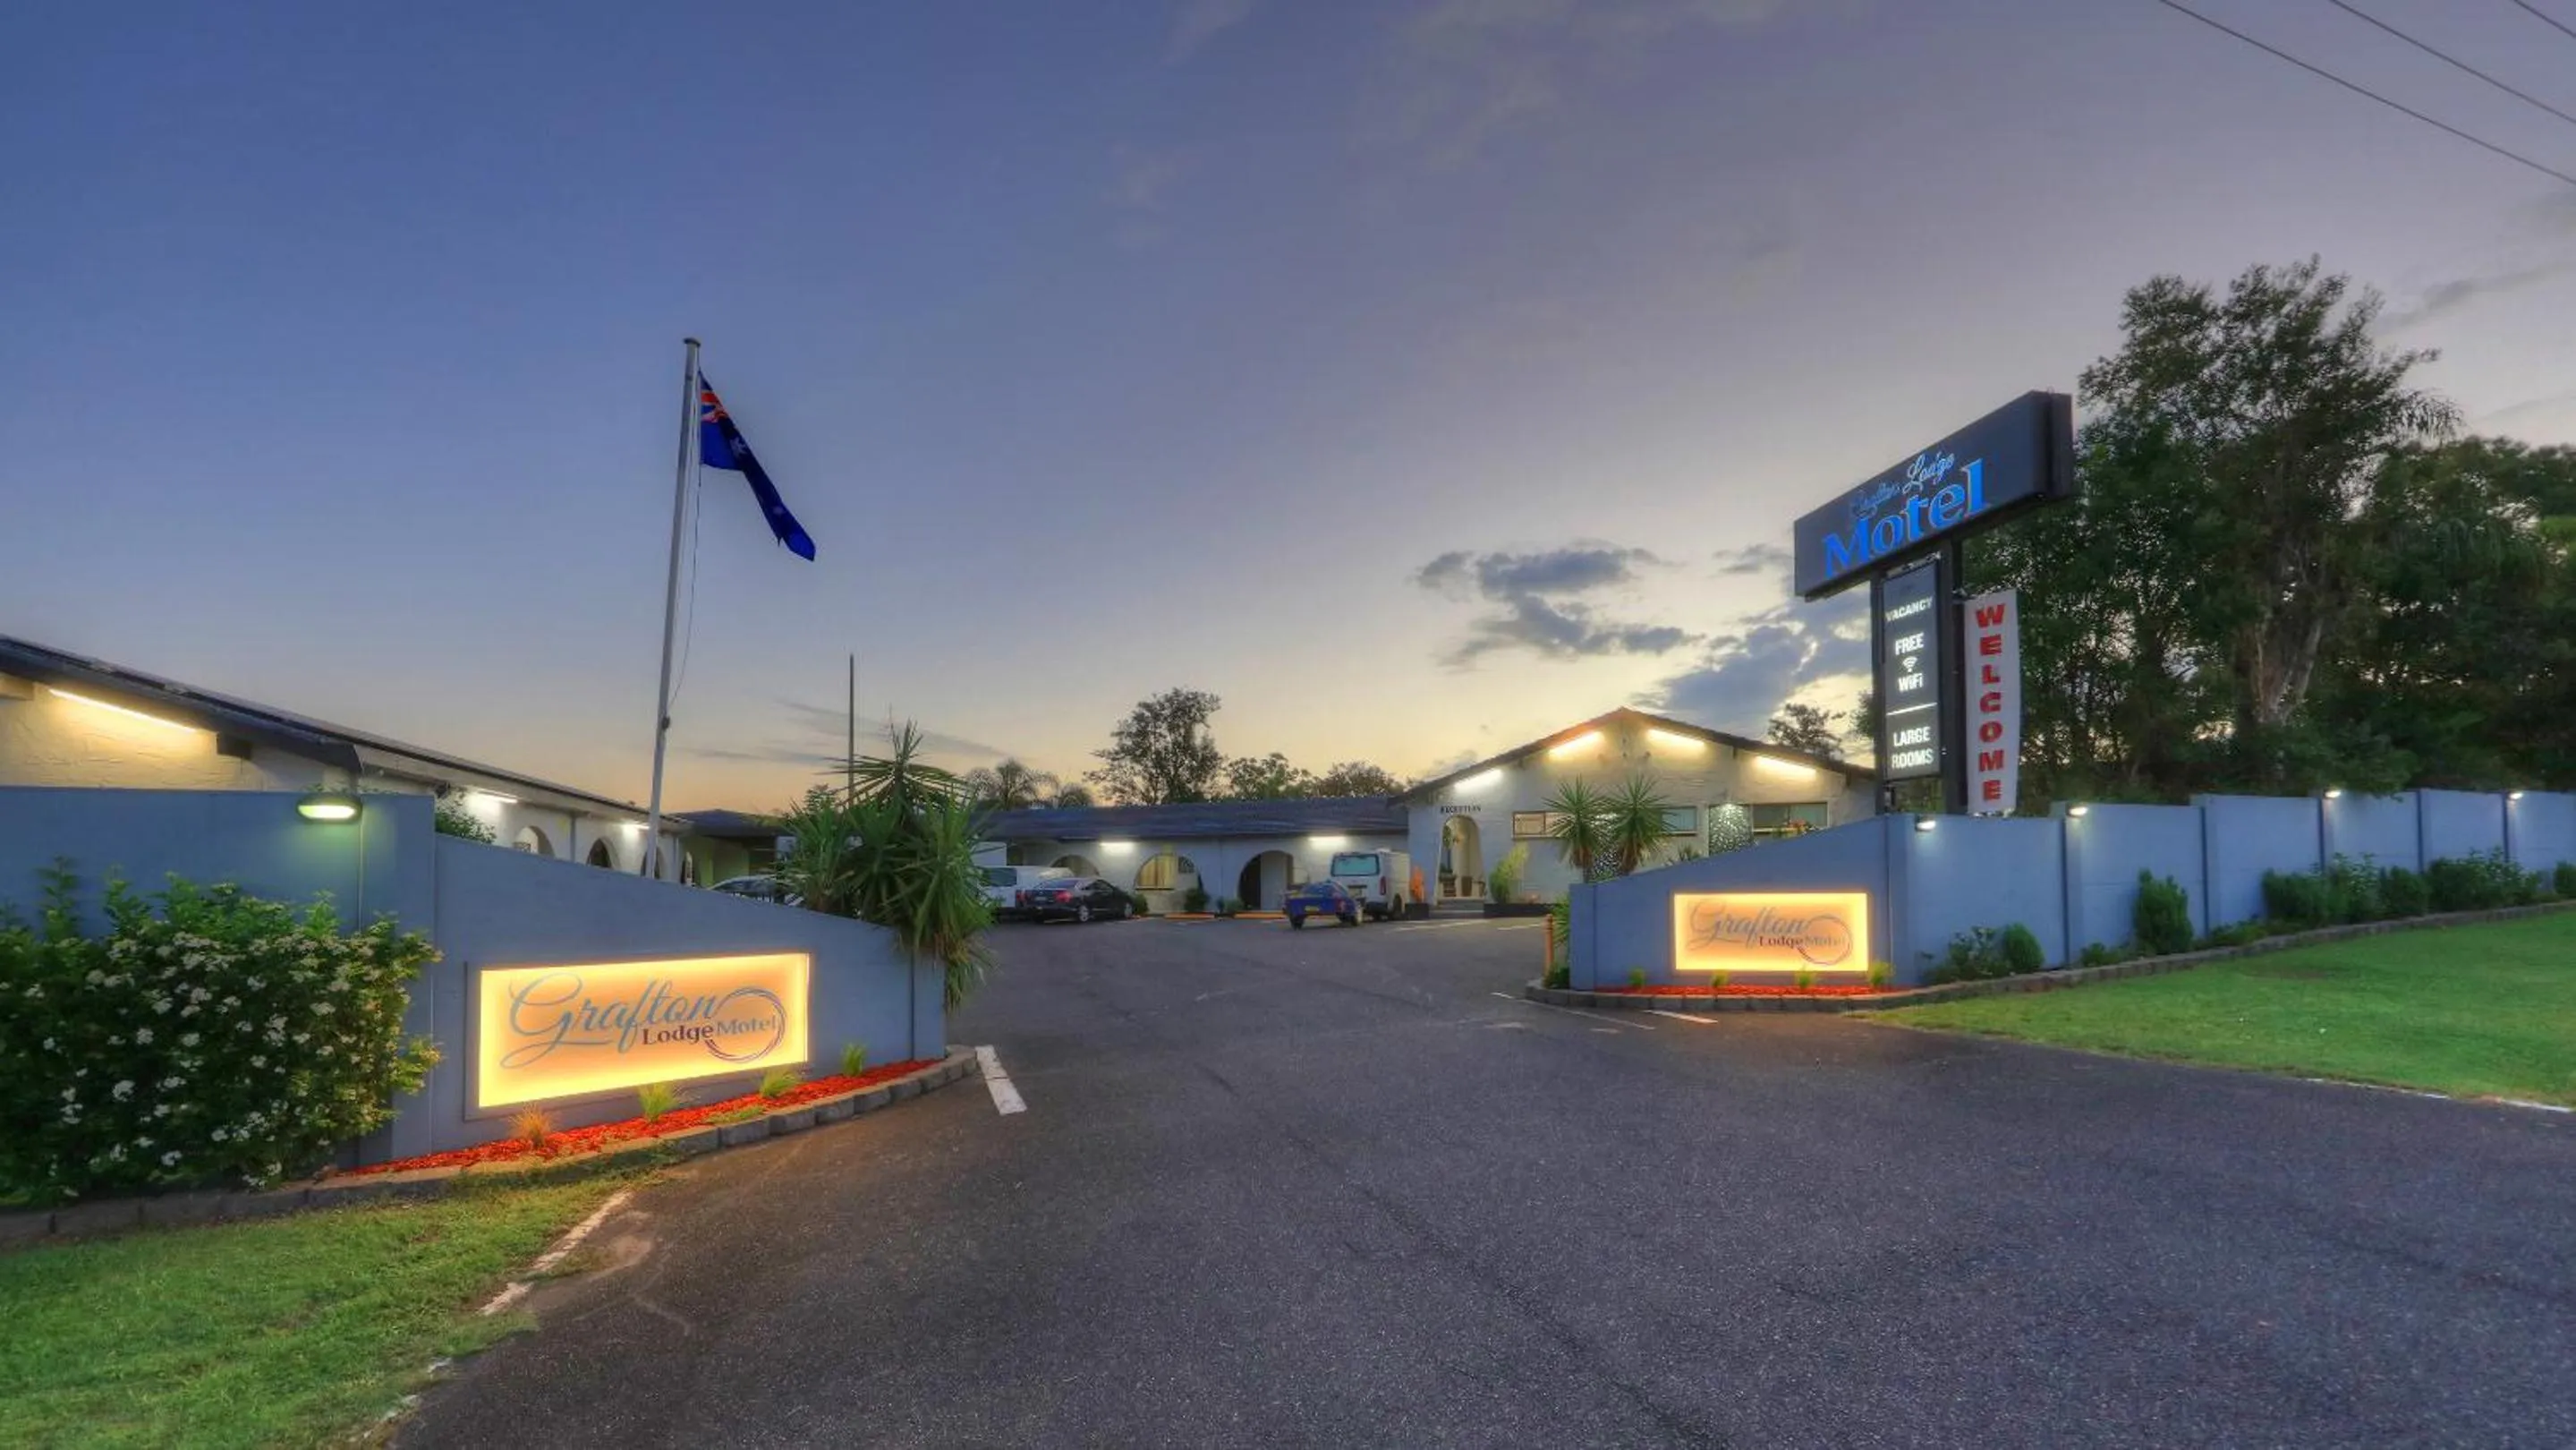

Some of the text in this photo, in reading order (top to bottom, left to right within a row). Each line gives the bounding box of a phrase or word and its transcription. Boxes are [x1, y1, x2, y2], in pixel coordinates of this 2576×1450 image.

[1822, 457, 1990, 579] Motel
[1885, 595, 1934, 622] VACANCY
[1895, 632, 1925, 655] FREE
[1898, 672, 1924, 693] WiFi
[1975, 603, 2006, 802] WELCOME
[1893, 726, 1931, 747] LARGE
[1892, 748, 1934, 769] ROOMS
[1686, 899, 1811, 951] Grafton
[500, 972, 717, 1069] Grafton
